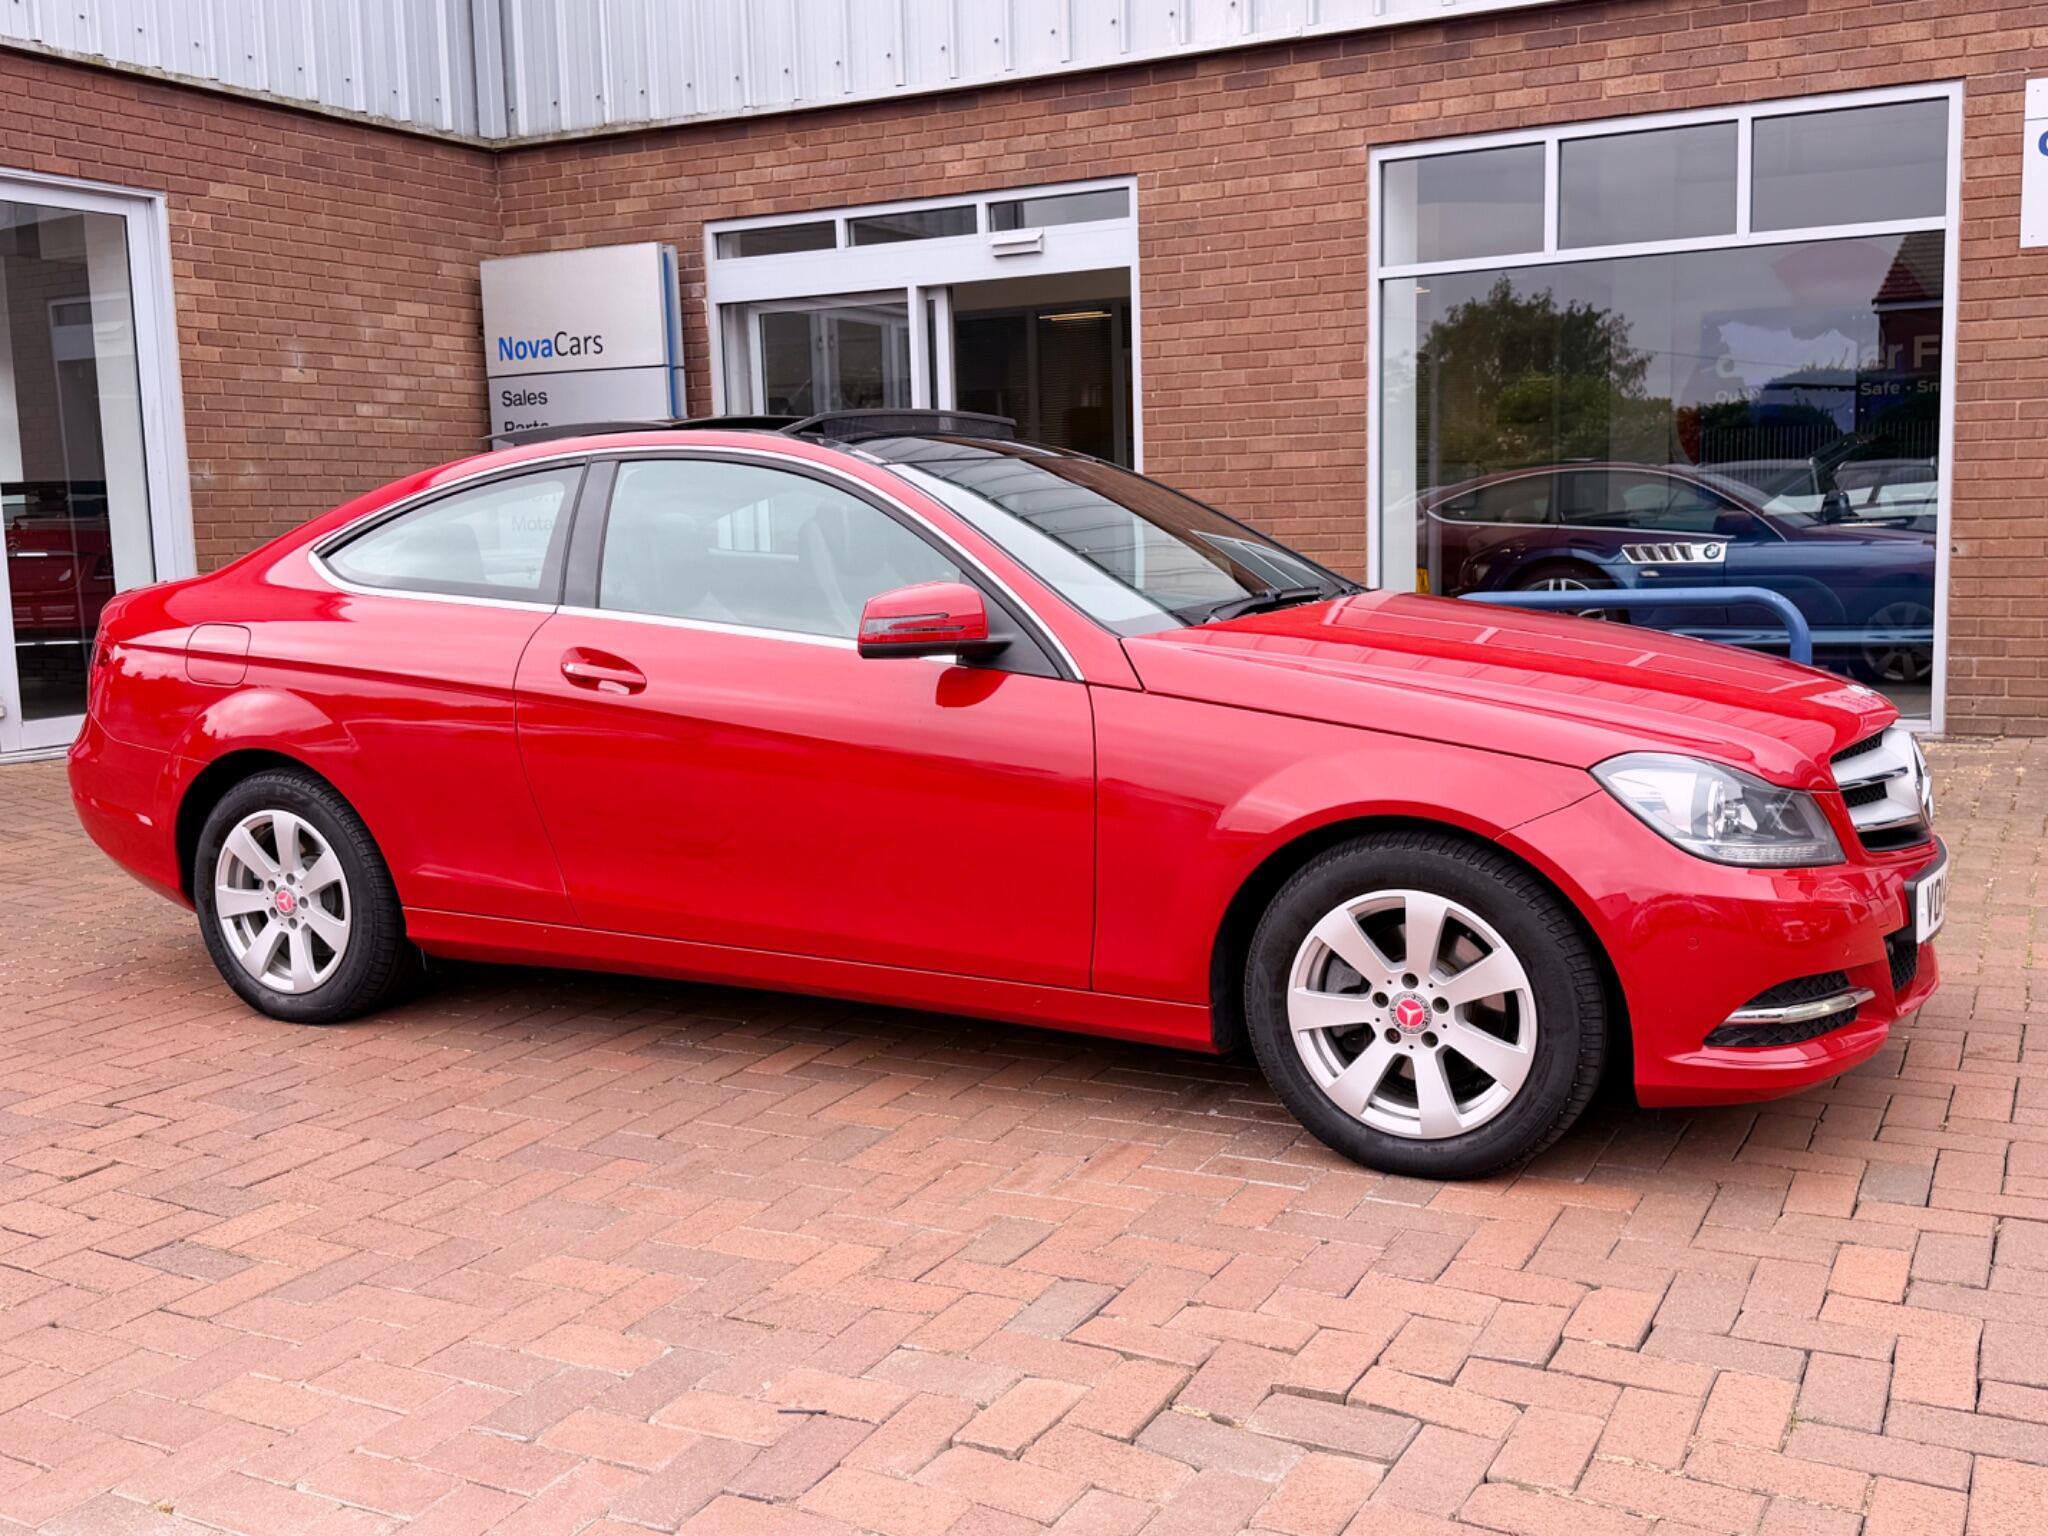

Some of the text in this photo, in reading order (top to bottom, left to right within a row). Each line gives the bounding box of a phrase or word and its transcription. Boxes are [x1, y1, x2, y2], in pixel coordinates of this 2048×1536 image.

[498, 330, 604, 362] NovaCars
[501, 388, 548, 408] Sales
[1859, 381, 1901, 396] Safe
